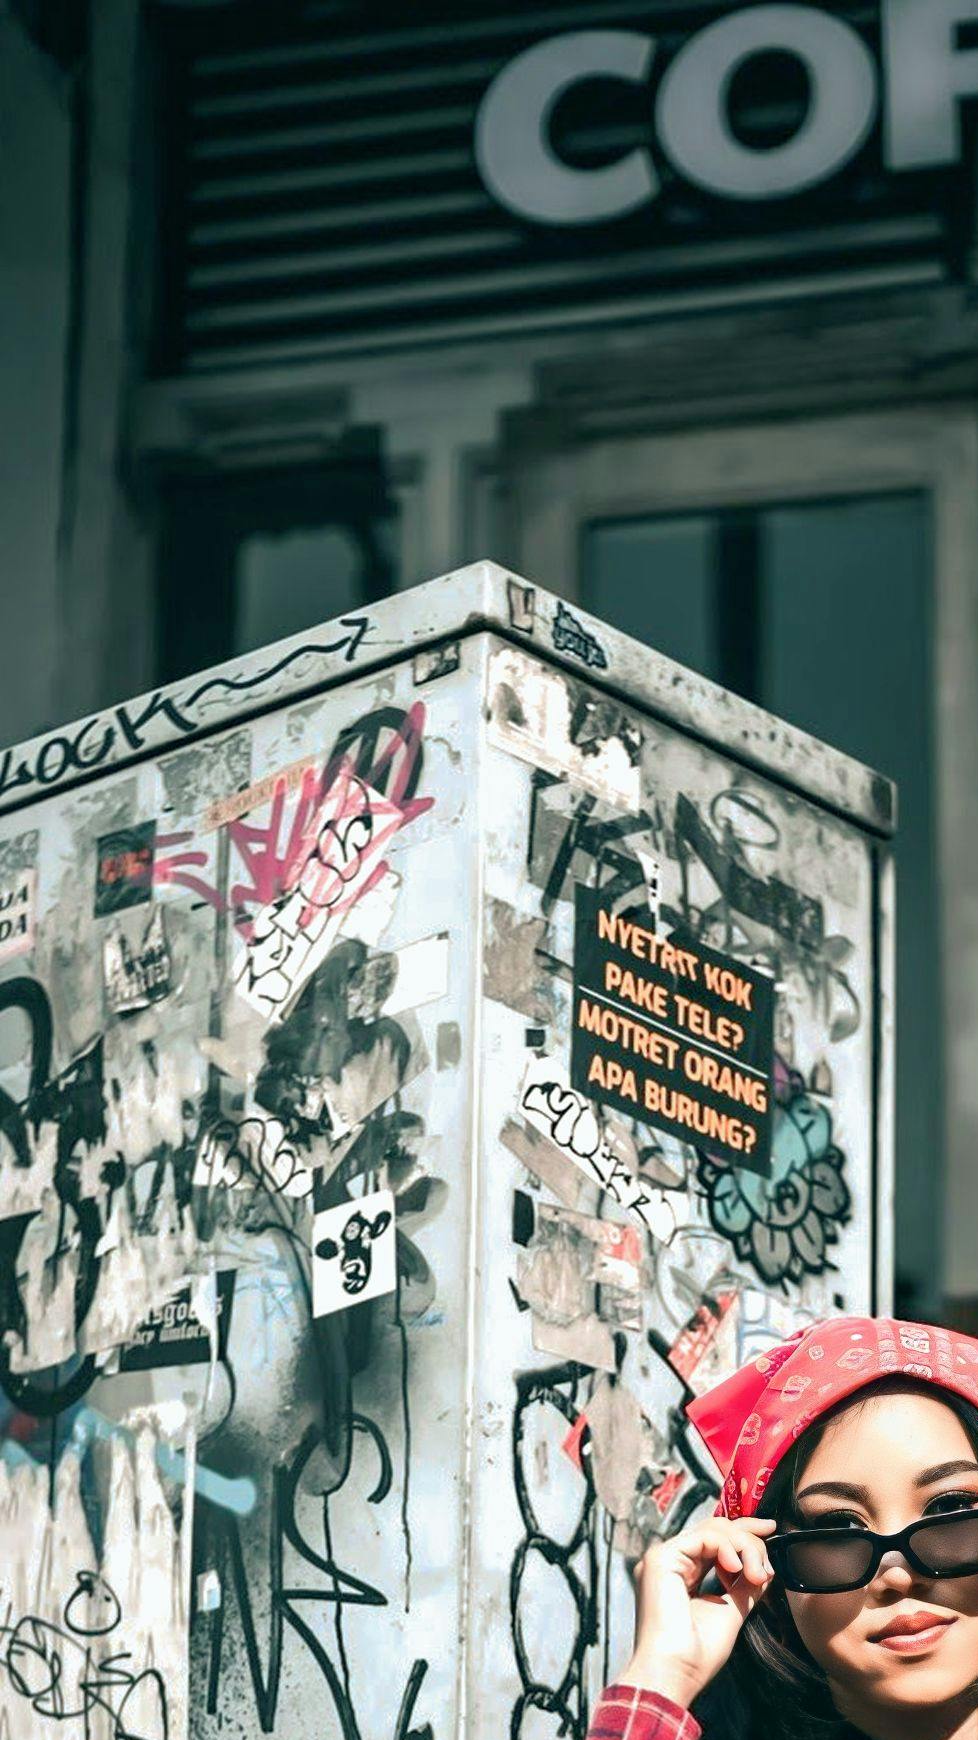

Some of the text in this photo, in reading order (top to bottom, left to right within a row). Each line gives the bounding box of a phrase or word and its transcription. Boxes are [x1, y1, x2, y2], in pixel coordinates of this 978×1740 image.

[598, 908, 752, 1012] NYETRIT KOK
[605, 961, 744, 1051] PAKE TELE?
[577, 998, 768, 1114] MOTRET ORANG
[587, 1054, 638, 1103] APA
[643, 1078, 756, 1155] BURUNG?
